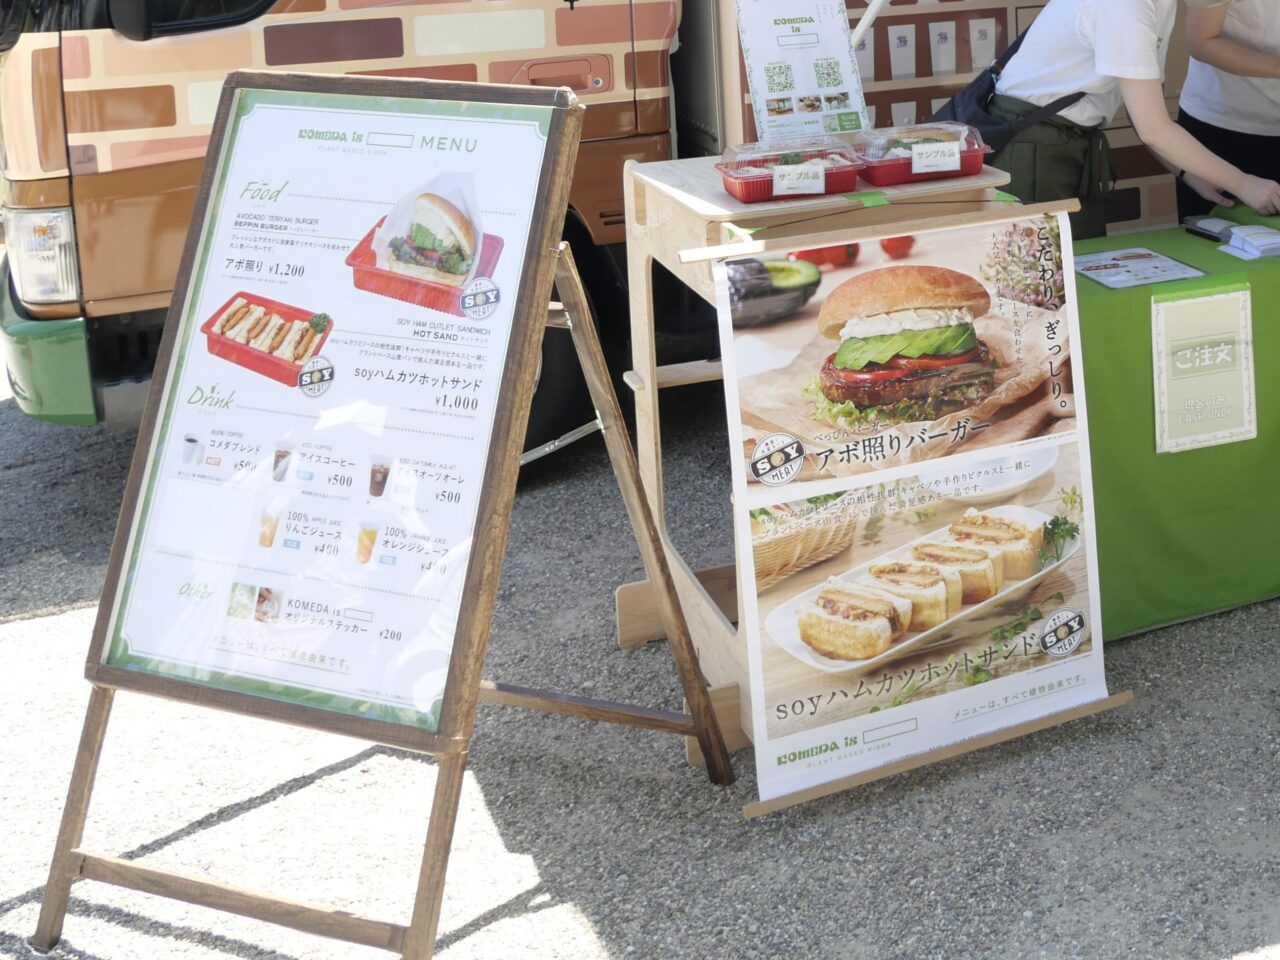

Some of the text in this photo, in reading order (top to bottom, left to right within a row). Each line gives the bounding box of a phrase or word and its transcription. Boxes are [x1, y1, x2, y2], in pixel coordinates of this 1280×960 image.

[773, 16, 816, 26] KOMEDA
[298, 128, 479, 153] KOMEDA is MENU
[915, 149, 957, 160] サンプル品
[778, 170, 821, 182] サンプル品
[240, 180, 290, 203] Food
[233, 220, 259, 229] BEPPIN
[259, 222, 289, 232] BURGER
[236, 213, 320, 227] AVOCADO TERIYAKI BURGER
[224, 257, 306, 278] アボ照り ¥1,200
[463, 289, 500, 308] SOY
[471, 306, 491, 319] MEAT
[1036, 224, 1068, 410] こだわり、 ぎっしり。
[396, 317, 492, 336] SOY HAM CUTLET SANDWICH
[412, 329, 432, 339] HOT
[432, 331, 459, 342] SAND
[1175, 342, 1233, 370] ご注文
[301, 368, 334, 386] SOY
[353, 367, 484, 393] soyハムカツホットサンド
[186, 385, 237, 410] Drink
[434, 394, 480, 411] ¥1,000
[1177, 406, 1233, 426] CASH ONLY
[813, 422, 890, 442] べっぴんバーガー
[208, 439, 263, 454] コメダブレンド
[814, 417, 991, 472] アボ照りバーガー
[298, 452, 356, 469] アイスコーヒー
[755, 444, 802, 476] SOY
[327, 473, 353, 488] ¥500
[771, 464, 796, 481] MEAT
[434, 489, 462, 505] ¥500
[286, 510, 310, 524] 100%
[285, 521, 343, 541] りんごジュース
[384, 525, 407, 540] 100%
[287, 597, 342, 617] KOMEDA is
[378, 628, 403, 642] ¥200
[1043, 616, 1084, 647] SOY
[775, 630, 1038, 721] soyハムカツホットサンド
[953, 675, 1086, 720] メニューは、すべて植物由来です。
[776, 735, 859, 767] KOMEDA is
[806, 756, 835, 769] PLANT
[836, 749, 865, 763] BASED
